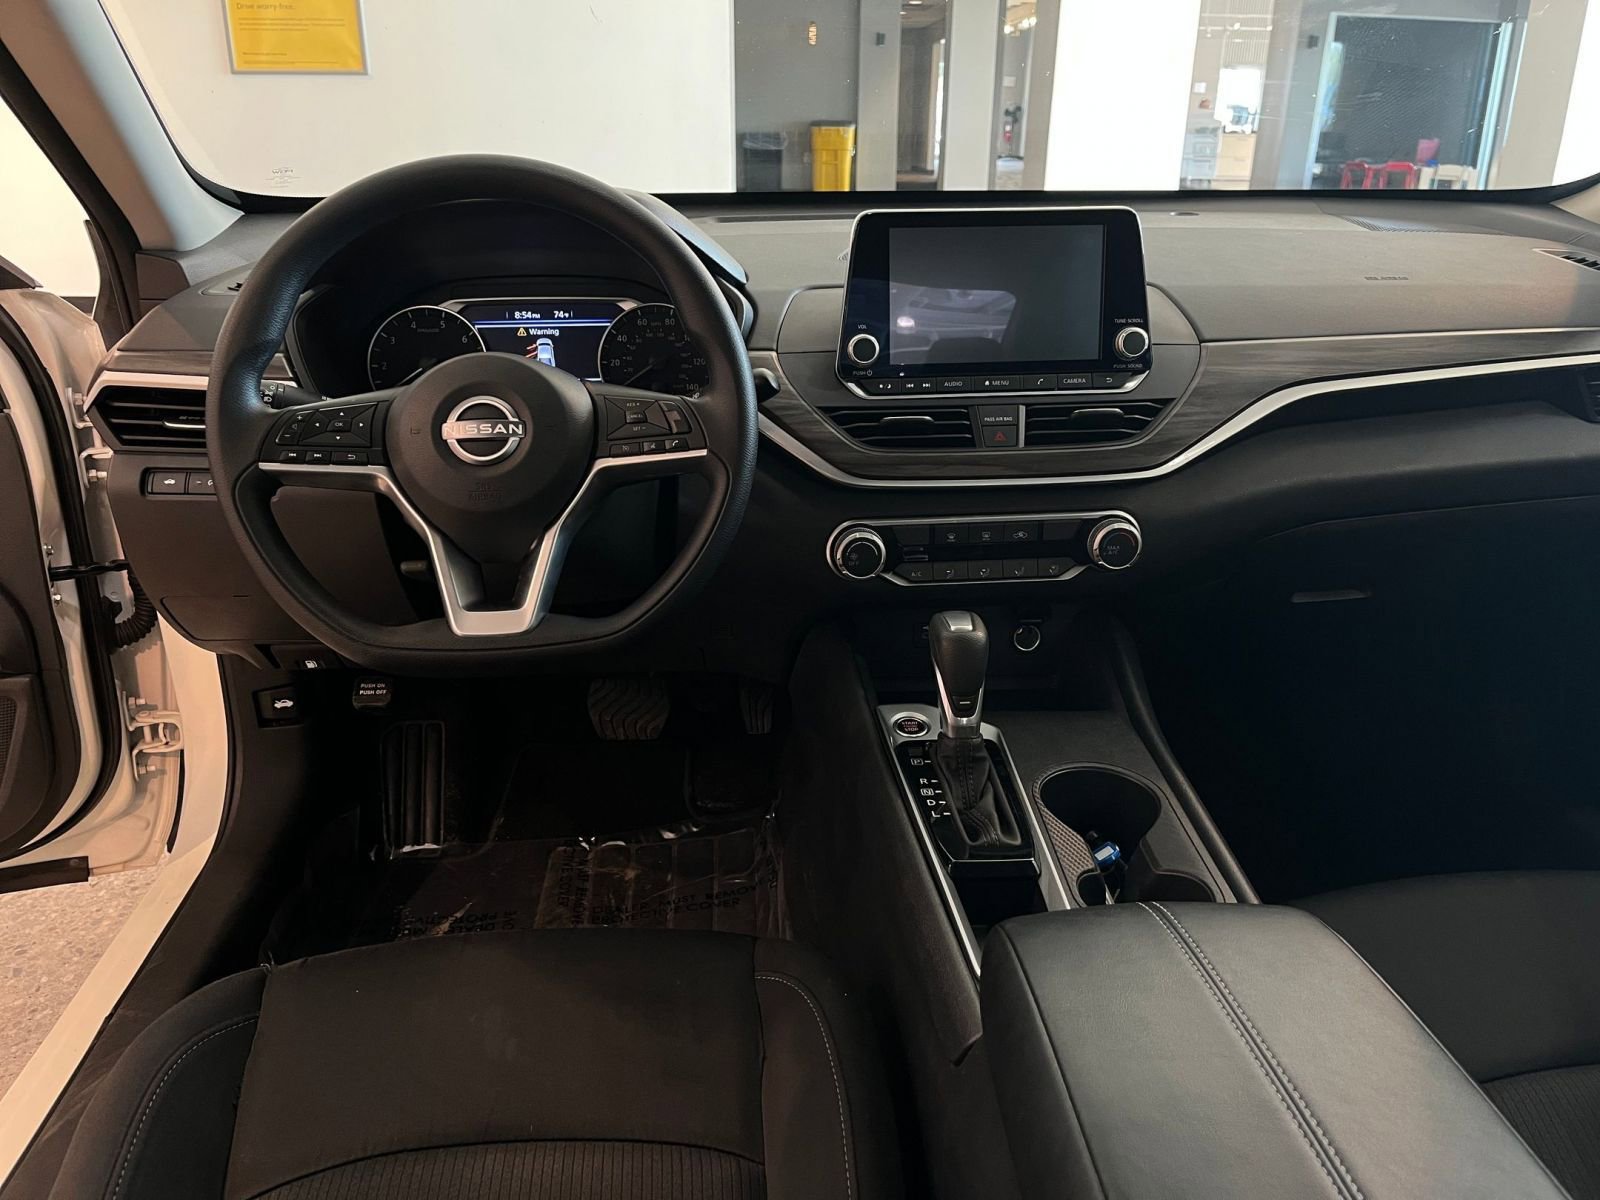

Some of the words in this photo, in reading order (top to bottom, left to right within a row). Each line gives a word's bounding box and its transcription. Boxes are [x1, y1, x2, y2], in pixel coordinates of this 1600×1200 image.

[410, 320, 417, 329] 4
[440, 320, 446, 329] 5
[637, 318, 648, 326] 60
[664, 318, 675, 326] 80
[528, 327, 560, 337] Warning
[390, 336, 396, 345] 3
[461, 335, 468, 344] 6
[616, 335, 627, 343] 40
[610, 359, 621, 367] 20
[693, 358, 706, 366] 120
[991, 379, 1010, 387] MENU
[443, 423, 523, 438] NISSAN
[658, 894, 697, 907] MUST
[686, 897, 741, 912] COVER
